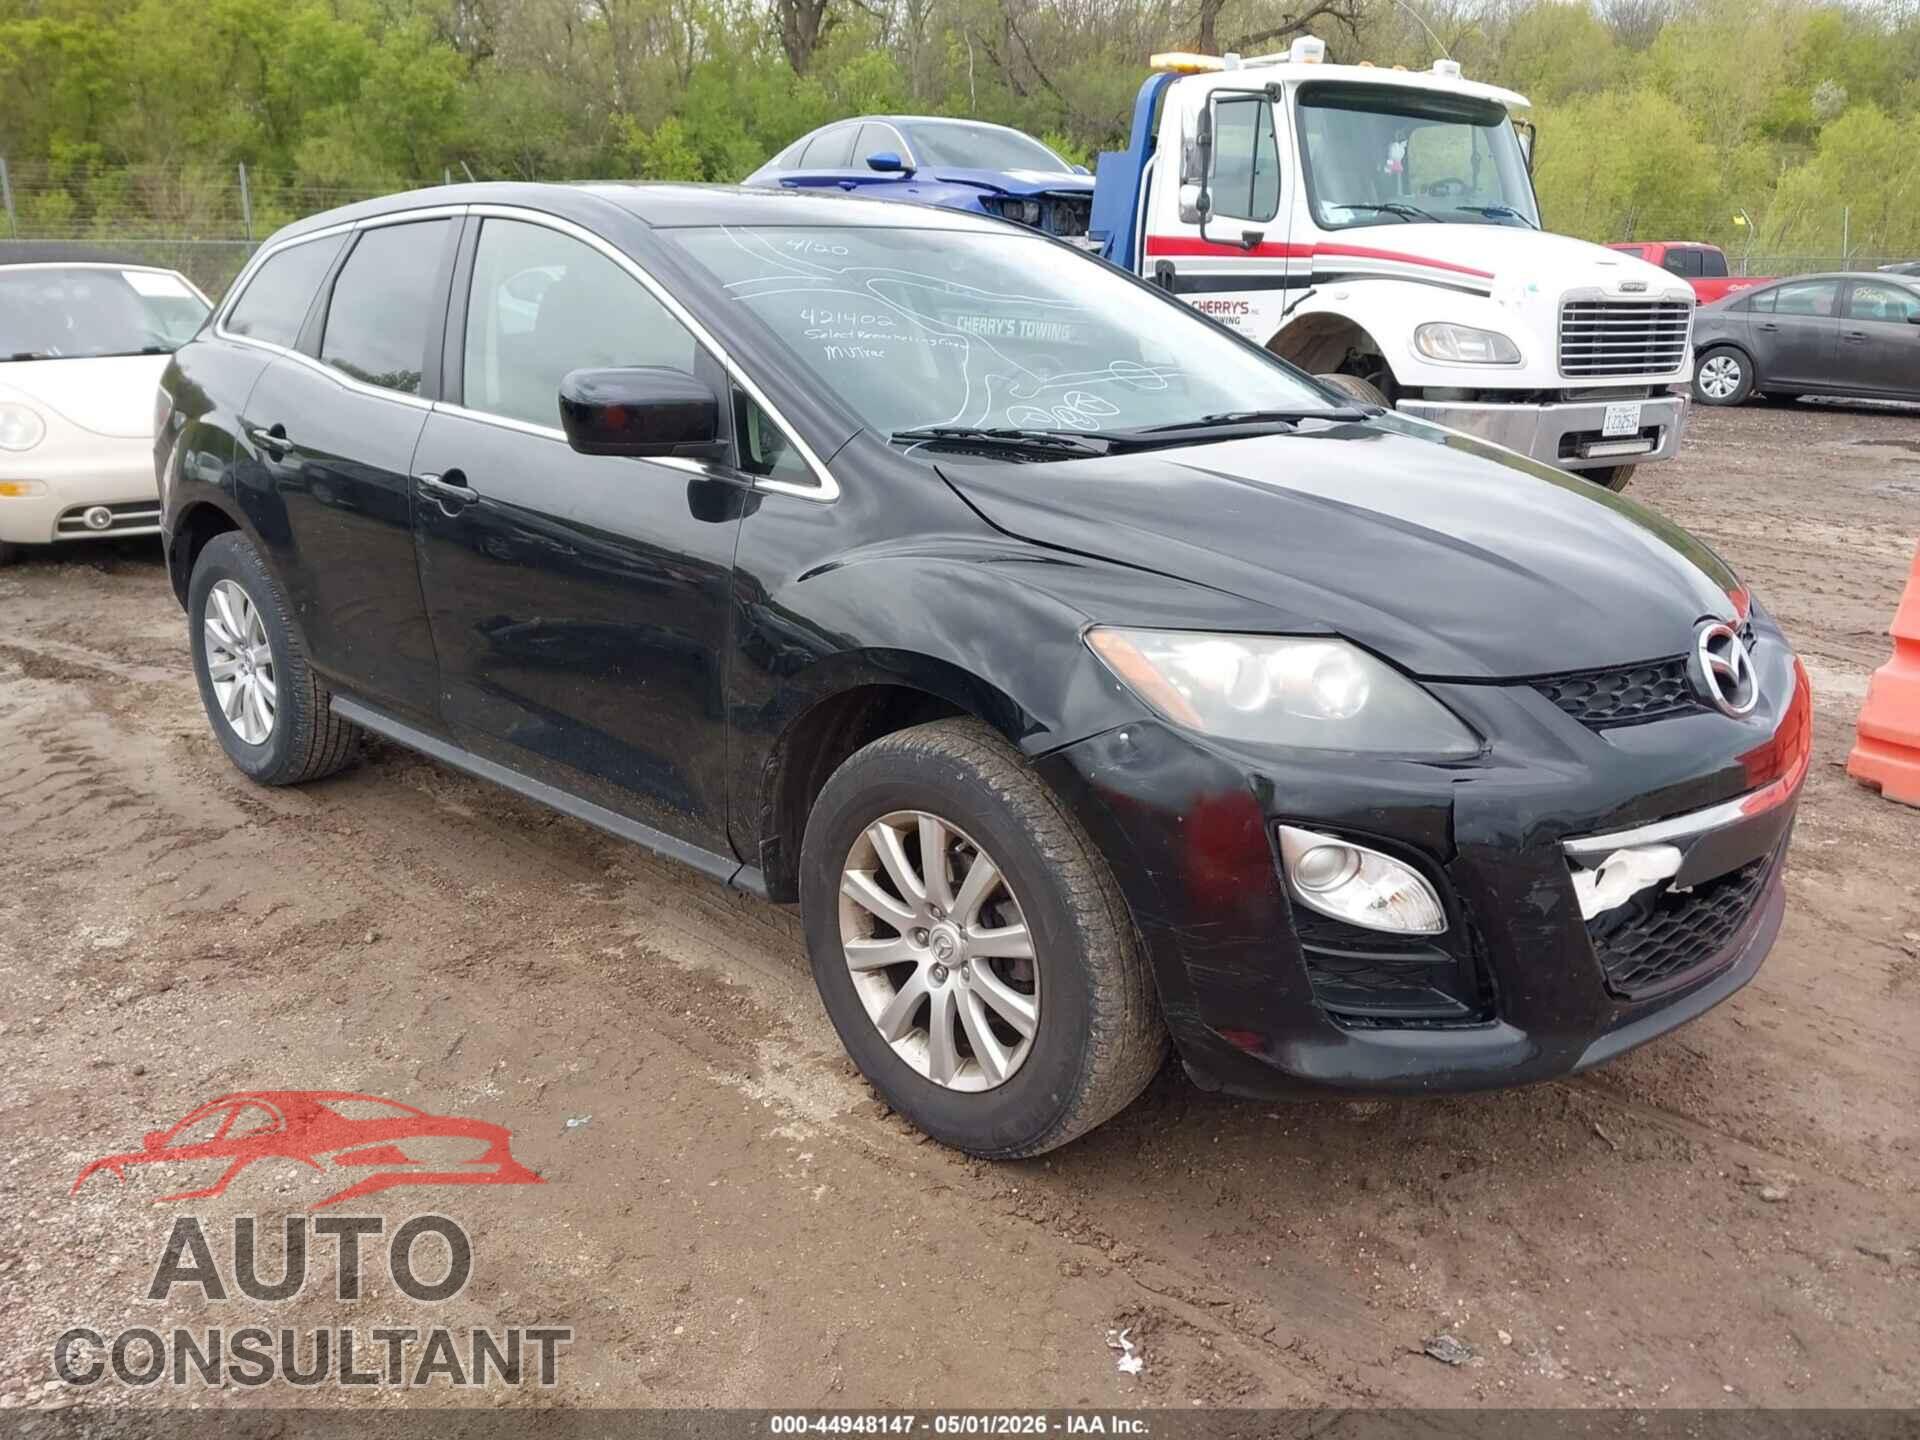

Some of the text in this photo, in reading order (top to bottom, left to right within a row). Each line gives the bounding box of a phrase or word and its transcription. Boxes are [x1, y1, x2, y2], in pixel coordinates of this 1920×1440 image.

[800, 307, 896, 326] 421402
[956, 315, 1072, 341] CHERRY'S TOWING
